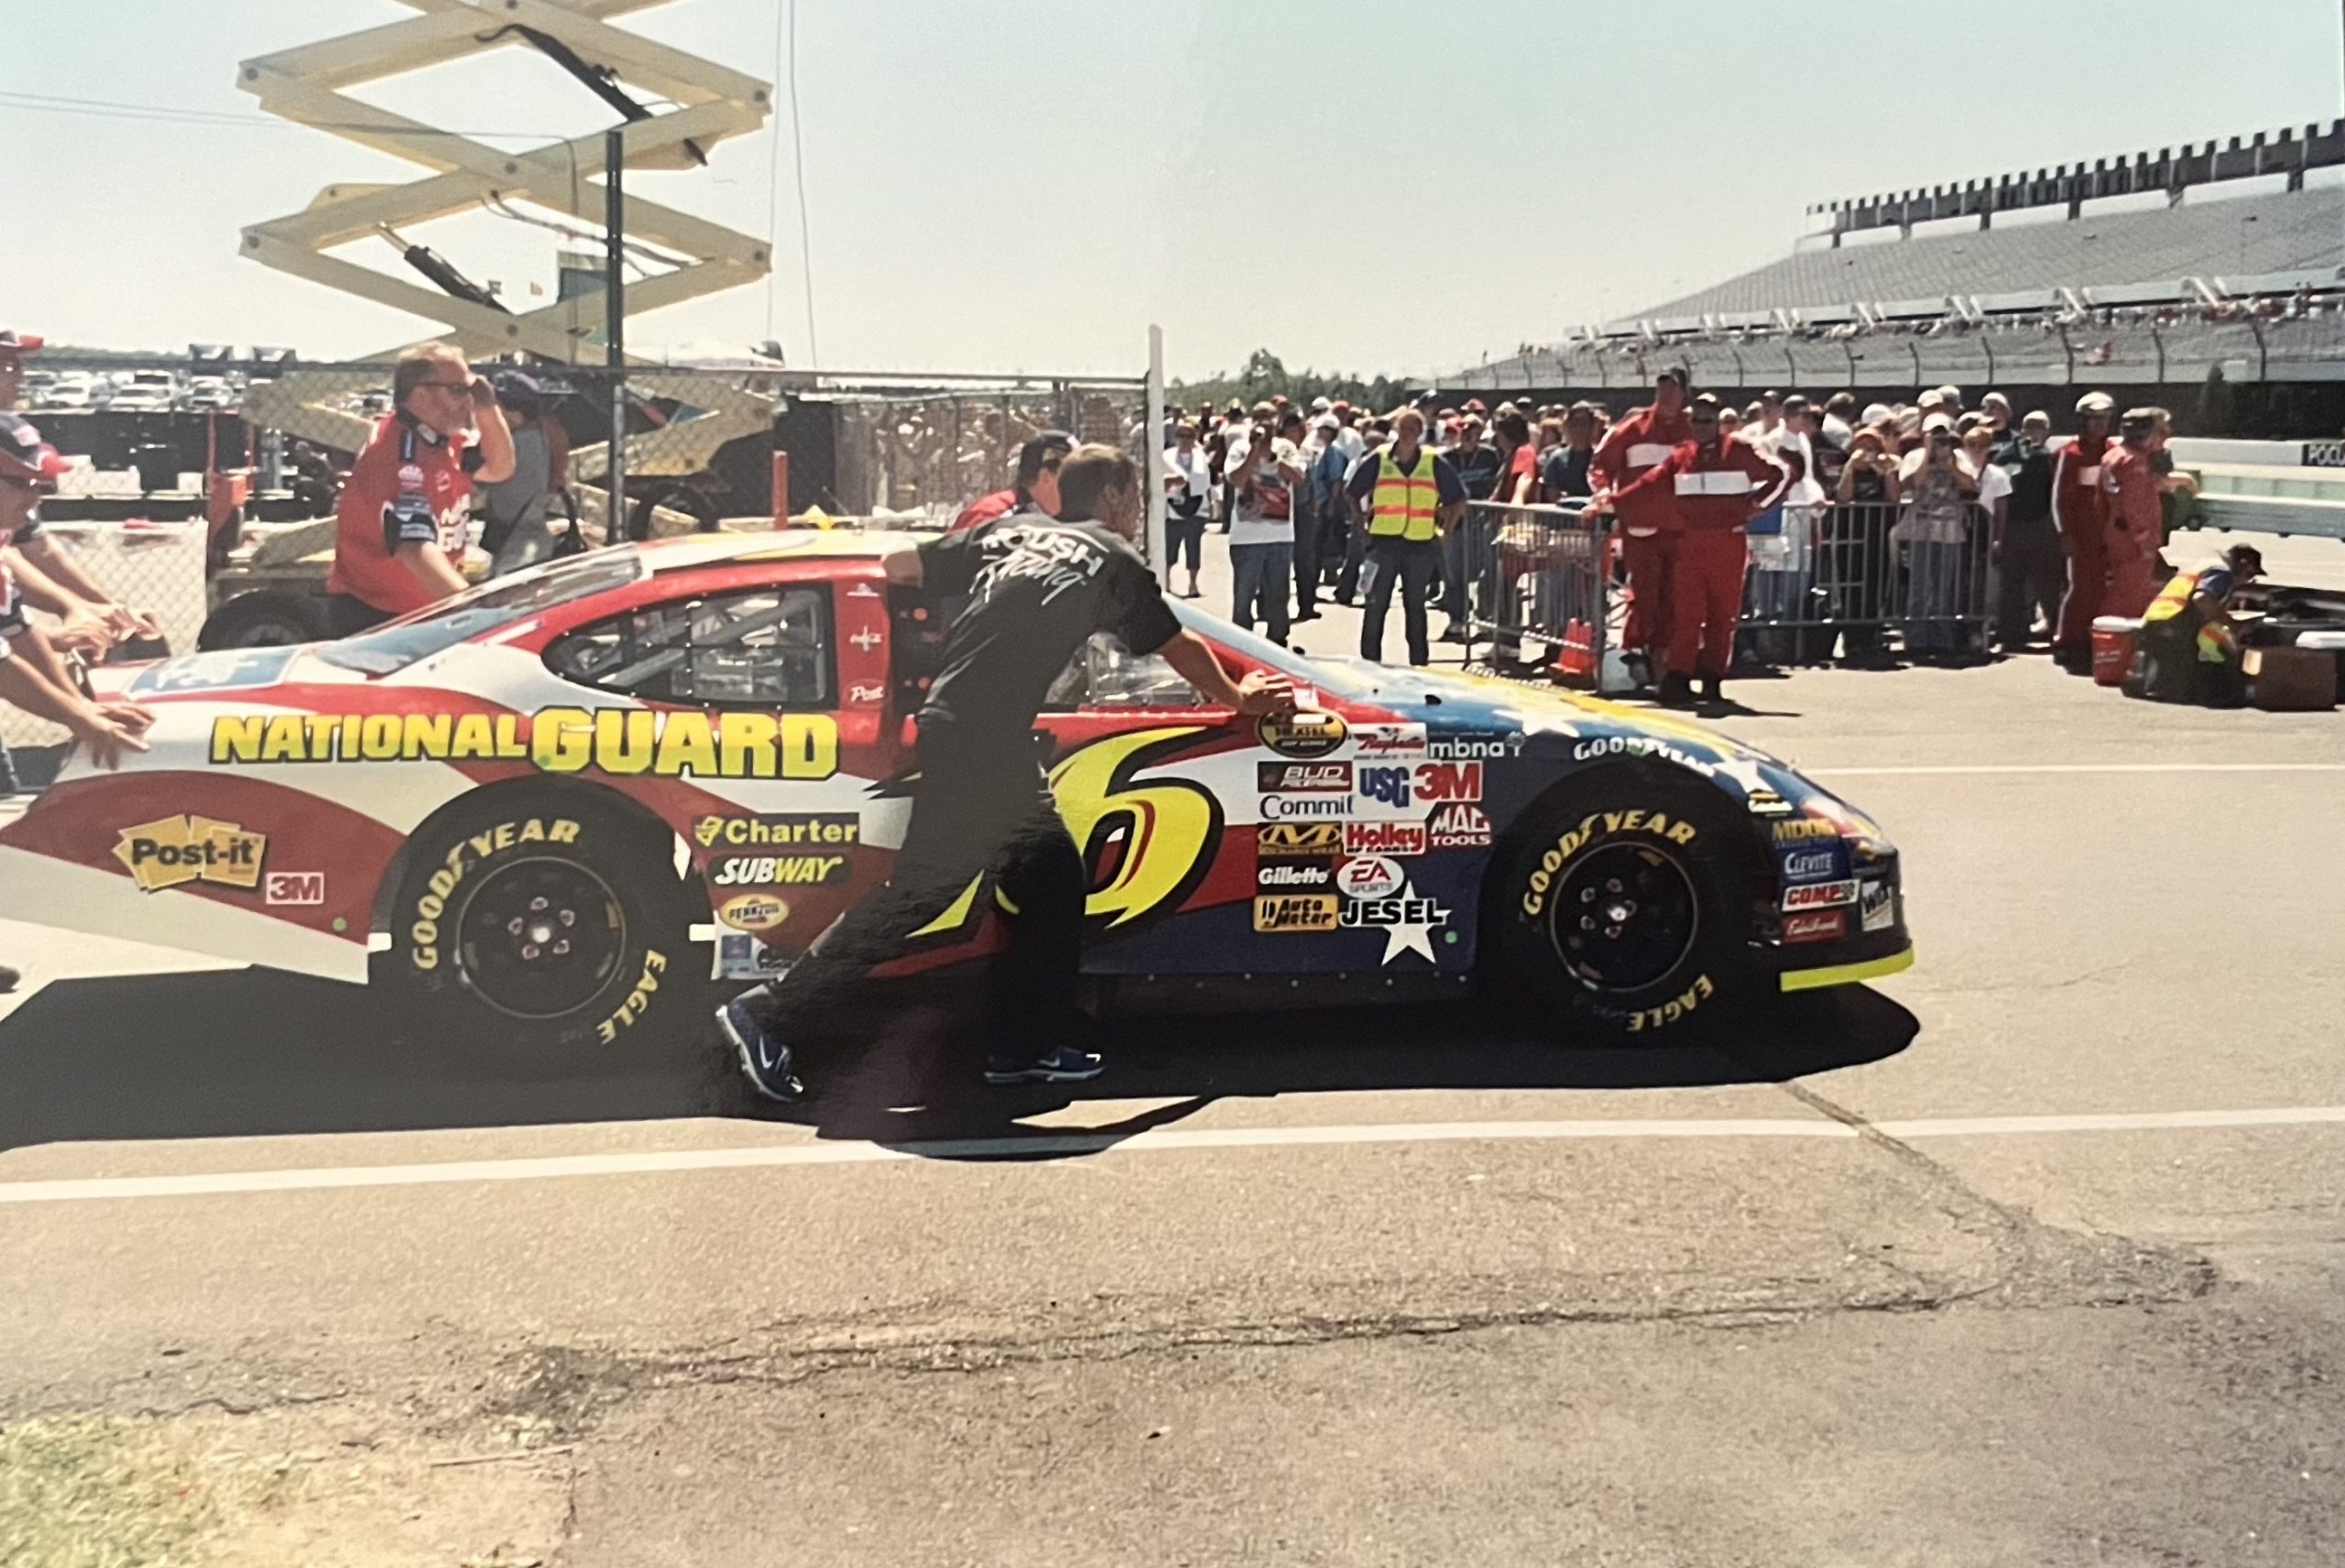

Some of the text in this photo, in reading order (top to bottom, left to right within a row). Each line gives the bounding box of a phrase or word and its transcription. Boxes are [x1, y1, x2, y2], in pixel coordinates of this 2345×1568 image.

[212, 706, 838, 780] NATIONAL GUARD
[1429, 736, 1505, 758] mbna
[1573, 736, 1716, 779] GOODYEAR
[1284, 766, 1345, 779] BUD
[1412, 762, 1480, 800] 3M
[1359, 766, 1411, 809] USG
[1260, 795, 1354, 821] Commit
[725, 818, 858, 845] Charter
[1347, 822, 1423, 852] Holley
[1431, 834, 1491, 847] TOOLS
[132, 837, 254, 866] Post-it
[1523, 810, 1696, 915] GOODYEAR
[714, 855, 844, 885] SUBWAY
[1259, 866, 1328, 885] Gillette
[1350, 859, 1392, 883] EA
[269, 875, 322, 901] 3M
[412, 818, 582, 970] GOODYEAR
[1282, 898, 1324, 912] Auto
[1341, 899, 1445, 926] JESEL
[596, 949, 668, 1045] EAGLE
[1626, 974, 1715, 1031] EAGLE
